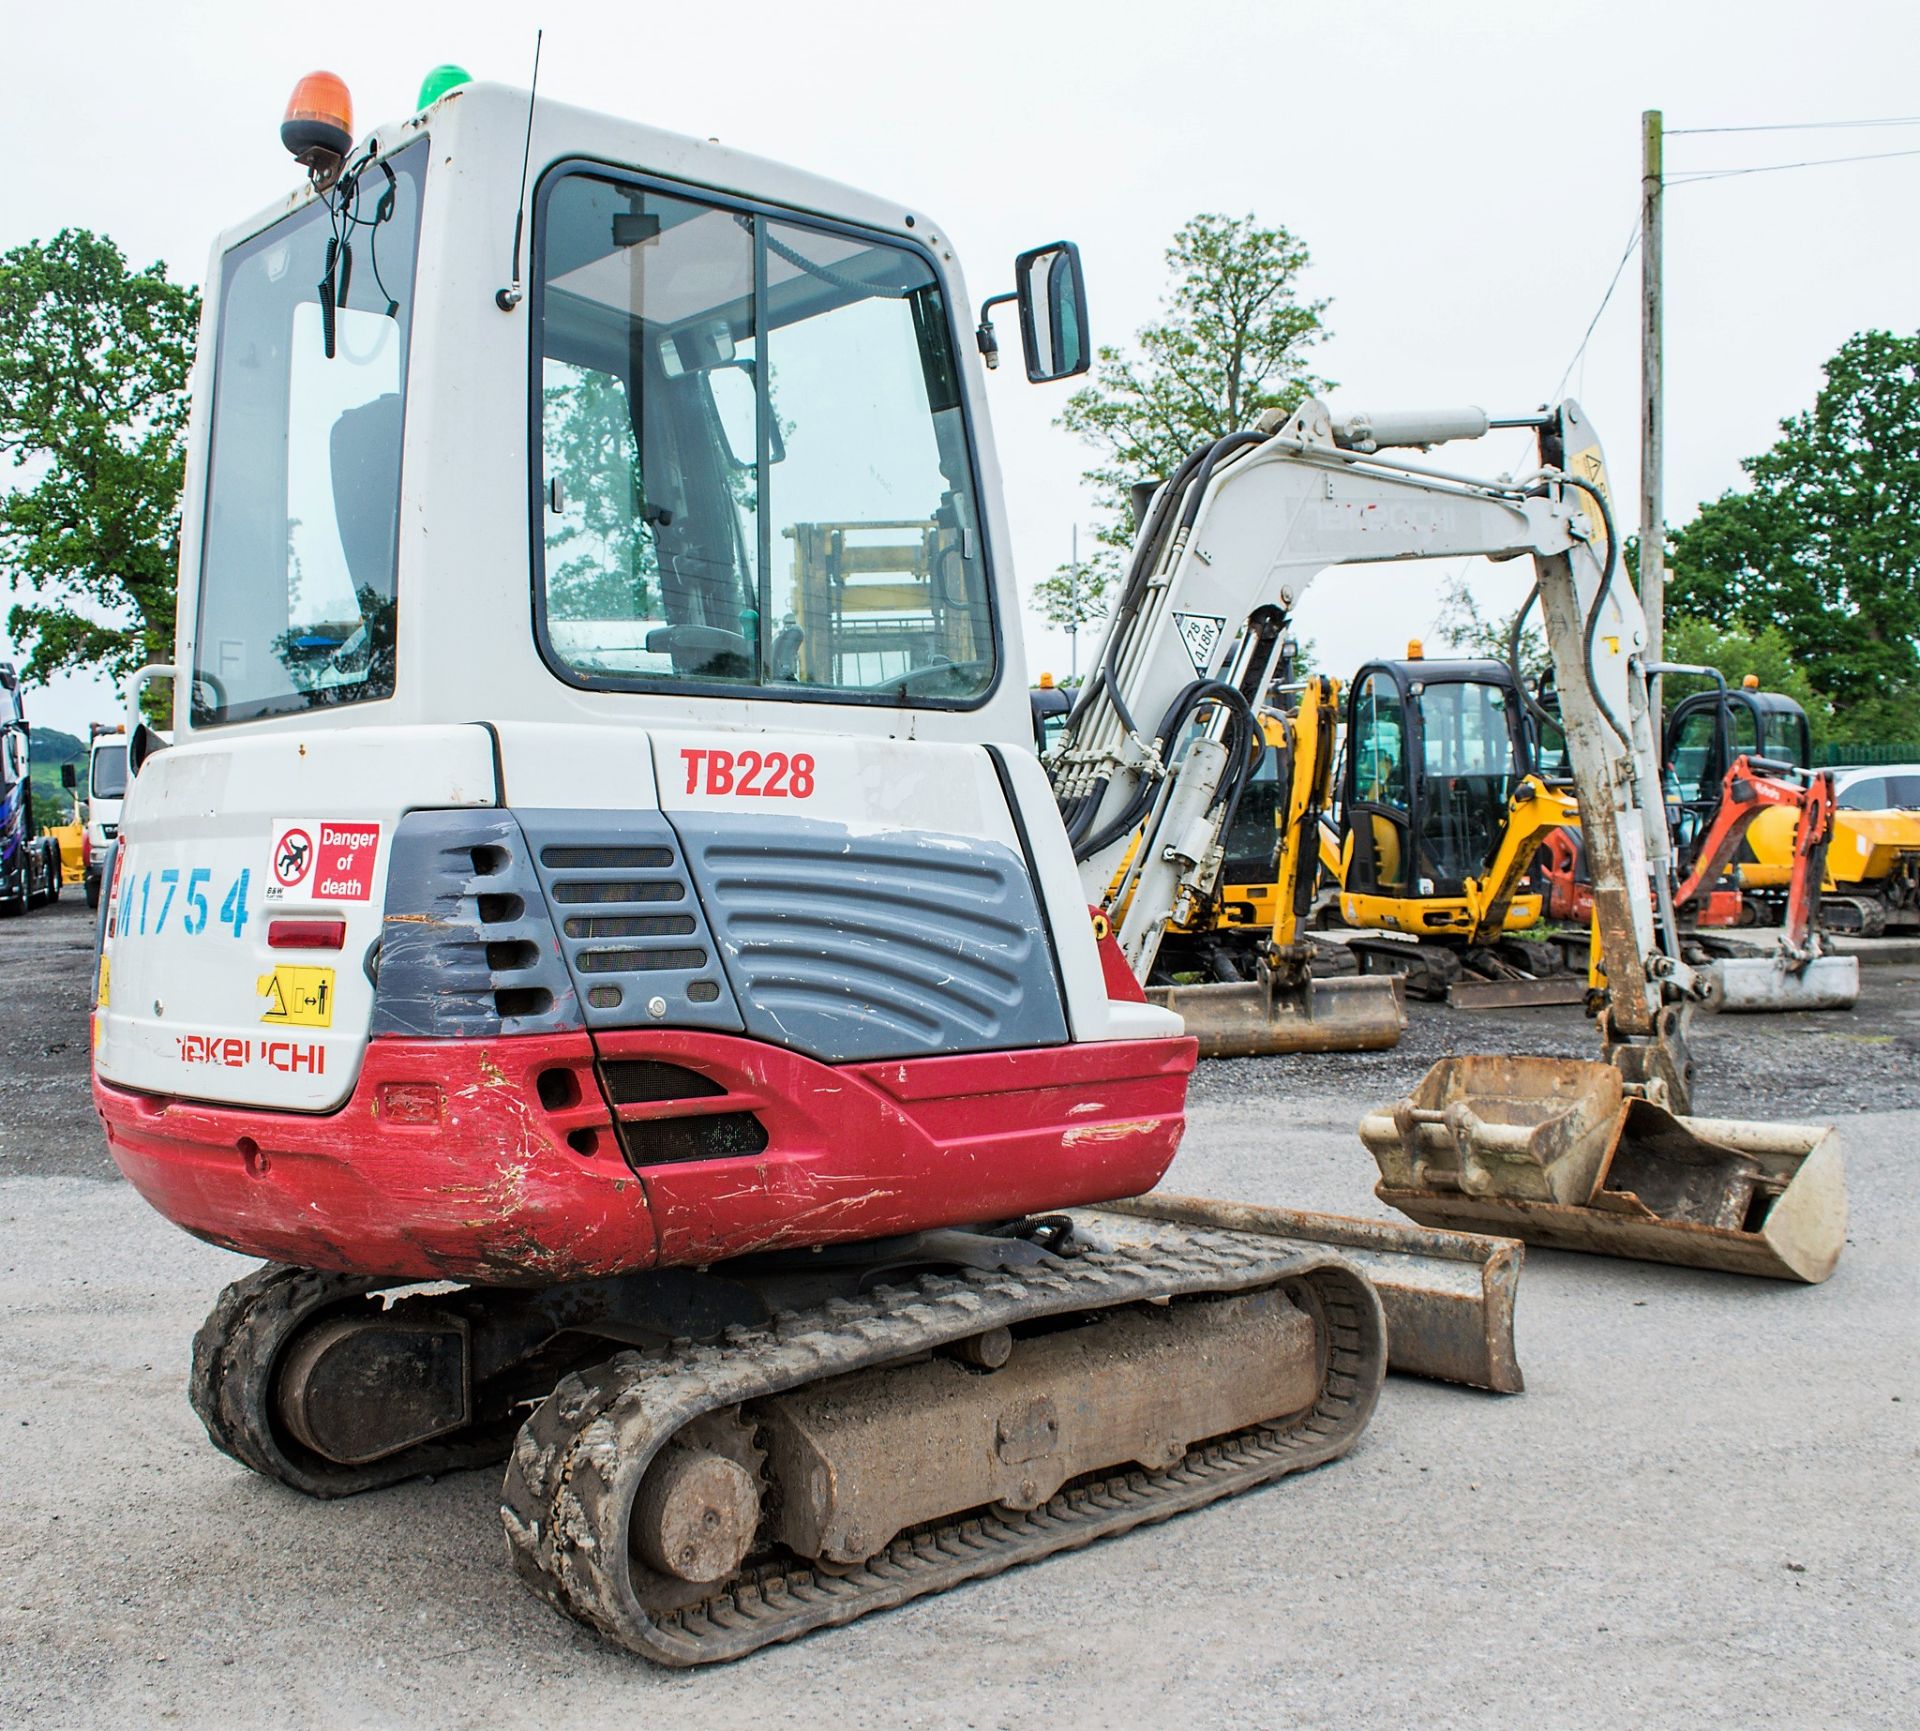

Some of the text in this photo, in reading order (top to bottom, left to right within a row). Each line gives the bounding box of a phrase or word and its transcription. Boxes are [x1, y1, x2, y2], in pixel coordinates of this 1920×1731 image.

[680, 749, 815, 799] TB228
[323, 828, 376, 850] Danger
[337, 854, 354, 871] of
[321, 877, 362, 896] death
